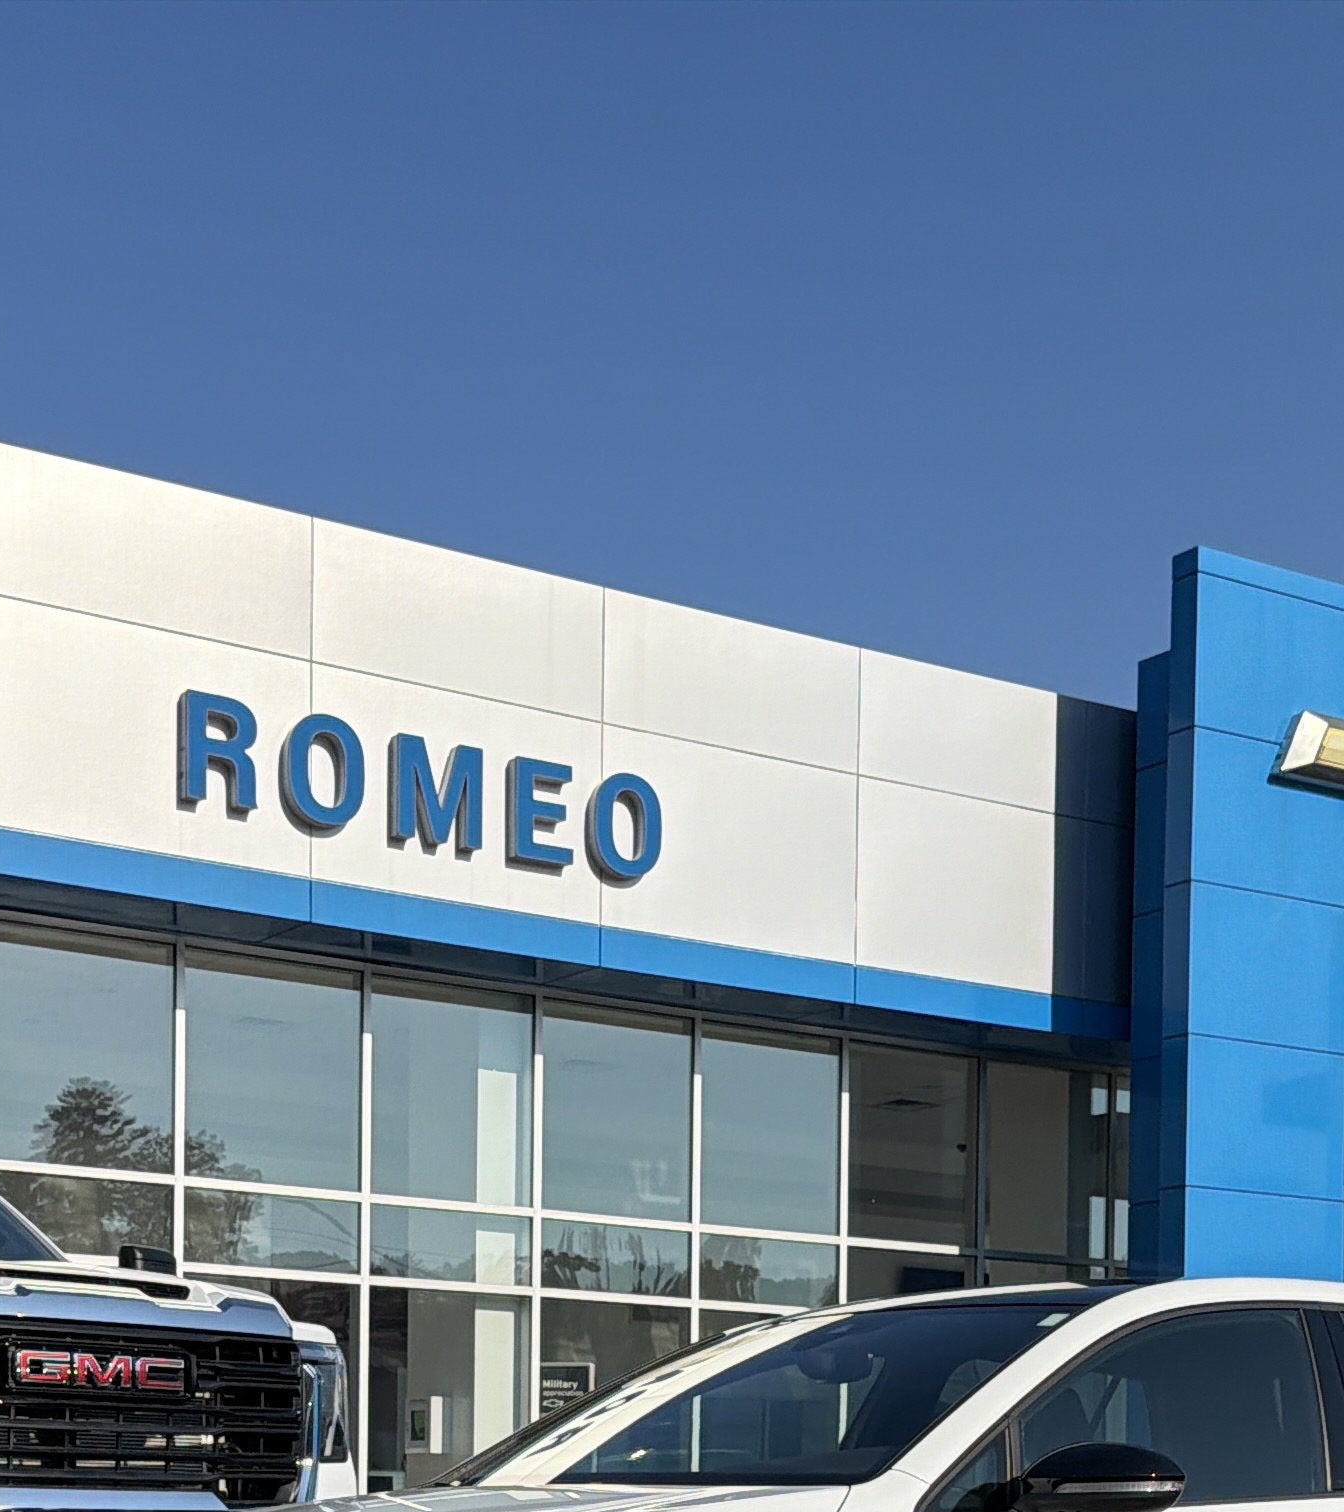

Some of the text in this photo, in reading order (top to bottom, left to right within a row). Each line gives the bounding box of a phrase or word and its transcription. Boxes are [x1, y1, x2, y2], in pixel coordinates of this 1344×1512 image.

[176, 689, 662, 888] ROMEO
[16, 1350, 185, 1390] GMC
[542, 1379, 579, 1391] Military
